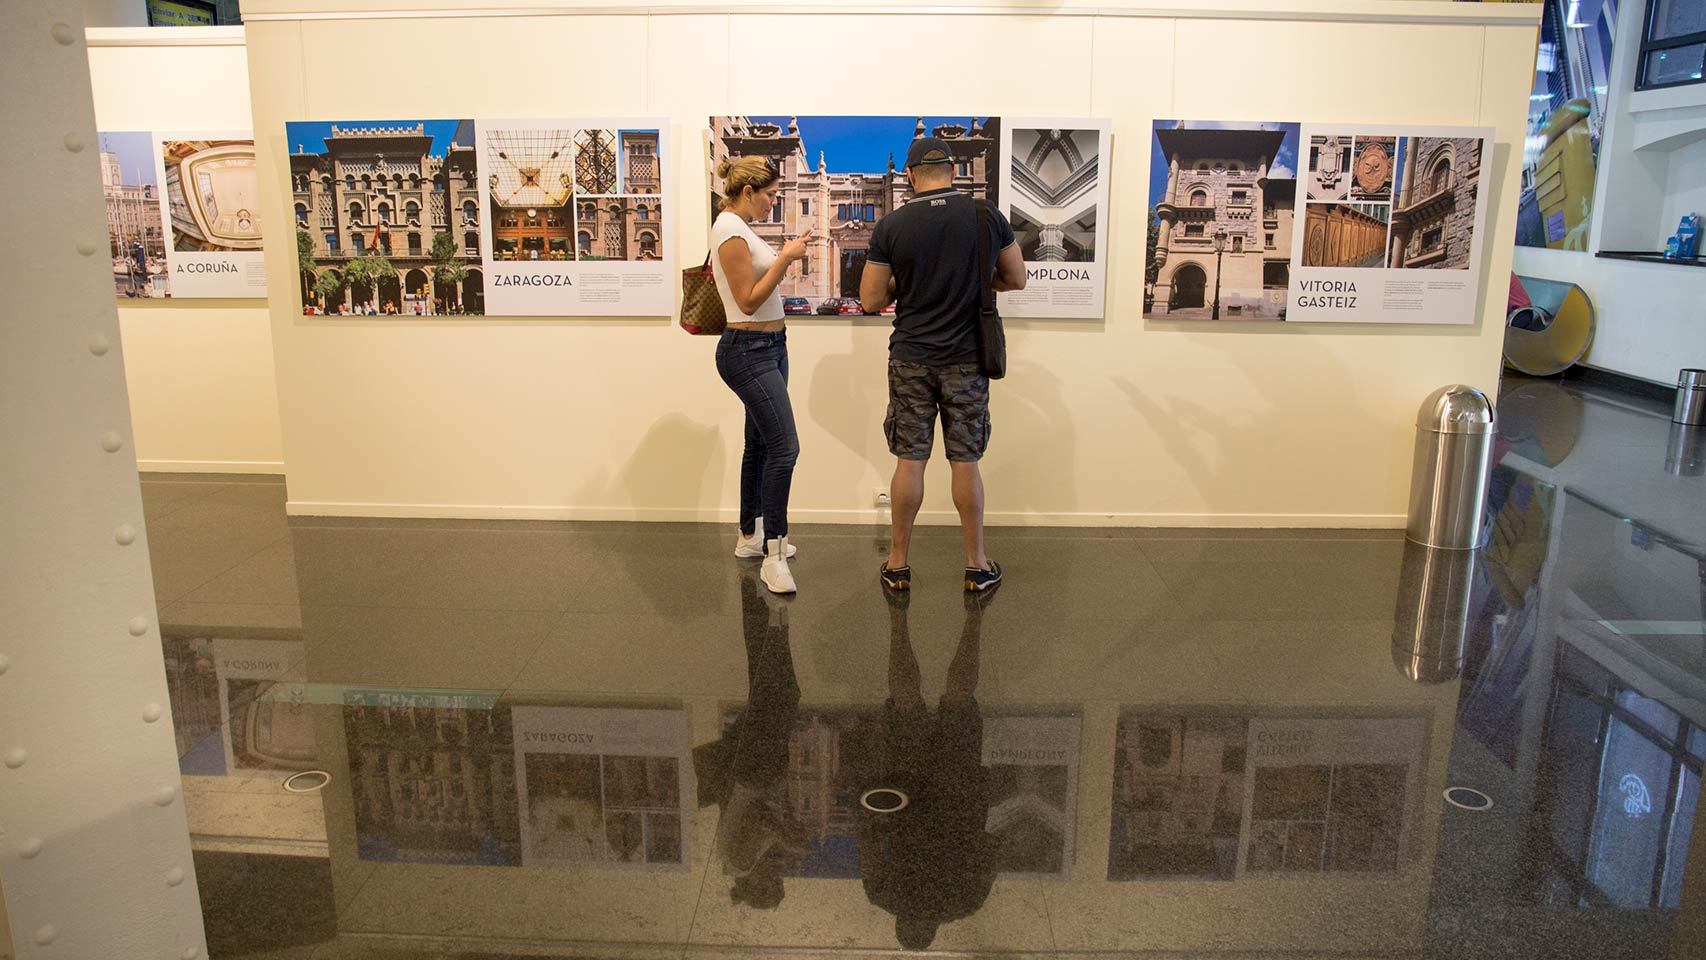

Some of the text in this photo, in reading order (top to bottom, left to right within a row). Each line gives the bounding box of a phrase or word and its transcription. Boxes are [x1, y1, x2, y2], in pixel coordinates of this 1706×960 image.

[177, 261, 239, 273] A CORUÑA
[494, 274, 573, 287] ZARAGOZA
[1026, 268, 1090, 281] MPLONA
[1299, 280, 1357, 293] VITORIA
[1297, 295, 1357, 309] GASTEIZ
